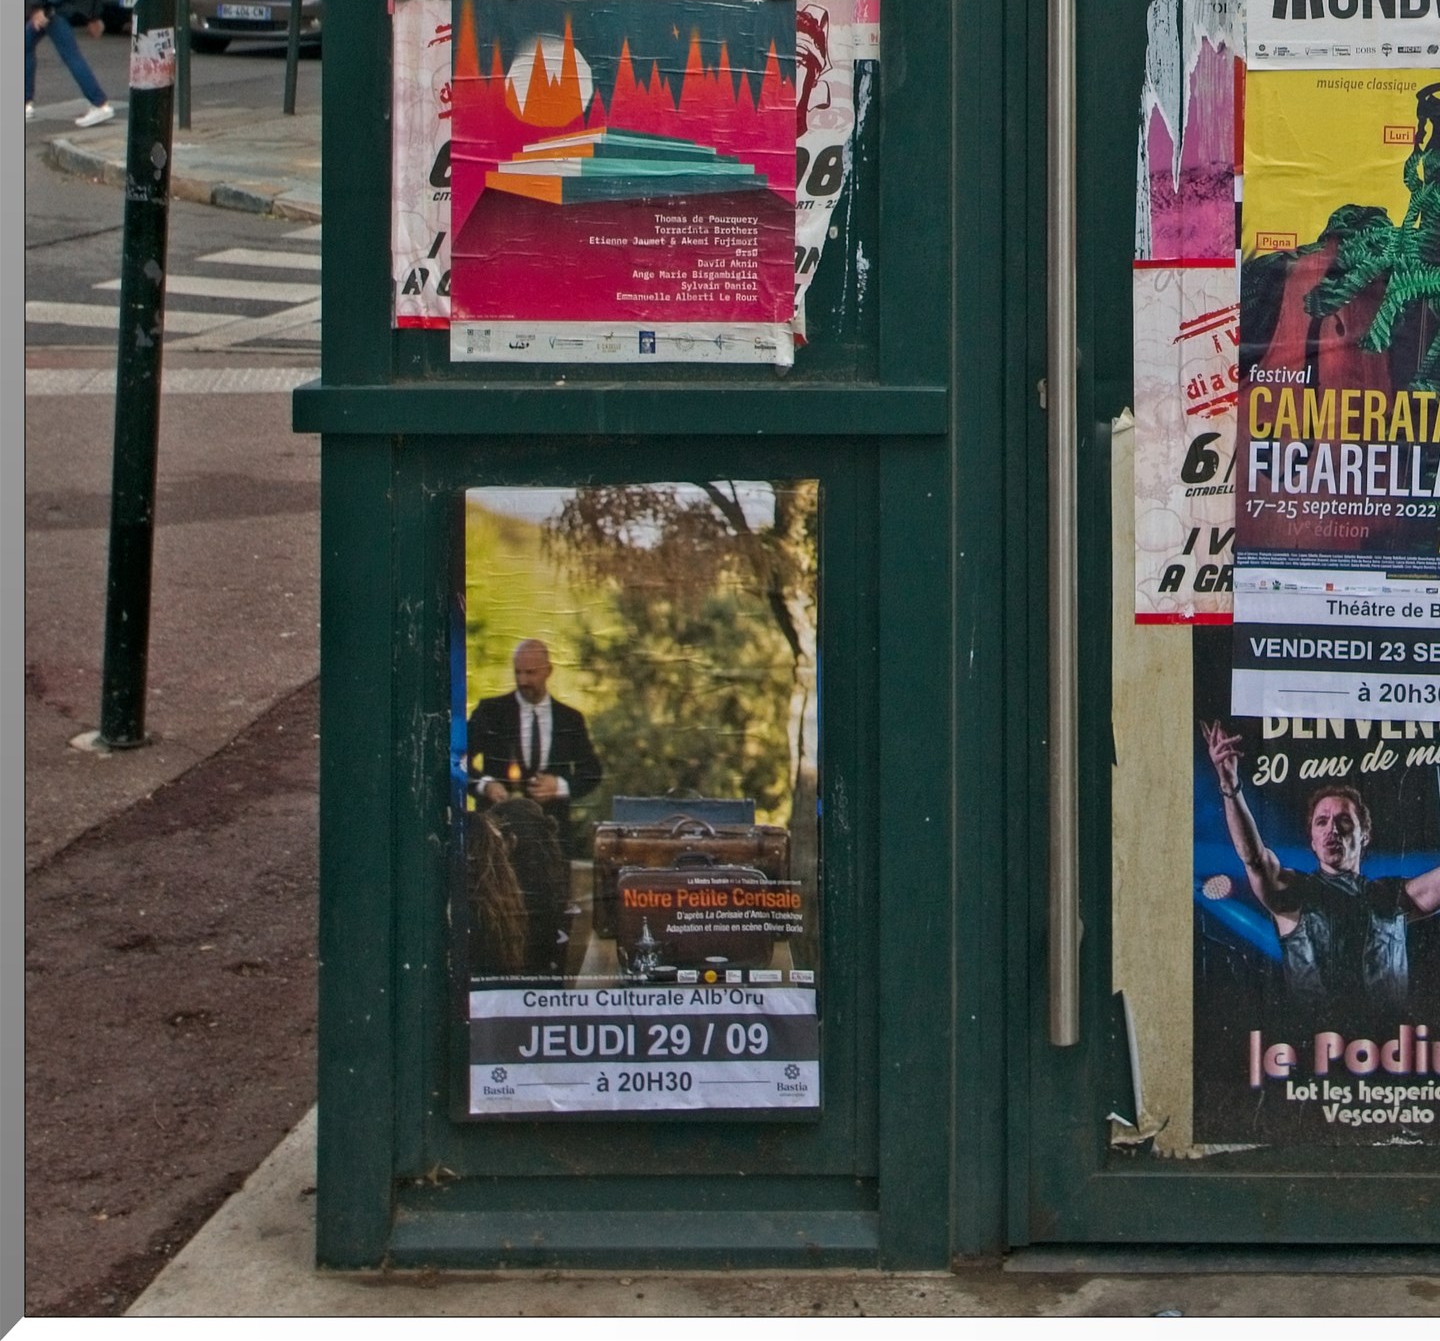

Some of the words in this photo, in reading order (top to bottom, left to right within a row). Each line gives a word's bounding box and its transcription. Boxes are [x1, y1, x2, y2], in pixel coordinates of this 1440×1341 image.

[1317, 78, 1364, 91] musique
[1367, 78, 1417, 92] classique
[1389, 130, 1410, 141] Luri
[654, 214, 687, 224] Thomas
[692, 214, 704, 224] de
[708, 215, 759, 226] Pourquery
[654, 225, 709, 235] Torracinta
[713, 226, 758, 235] Brothers
[589, 236, 628, 246] Etienne
[632, 236, 666, 246] Jaumet
[669, 236, 677, 246] &
[681, 236, 709, 246] Akemi
[713, 236, 758, 247] Fujimori
[1262, 237, 1291, 249] Pigna
[697, 259, 726, 268] David
[730, 259, 758, 268] Aknin
[632, 270, 655, 281] Ange
[659, 270, 687, 280] Marie
[692, 270, 758, 281] Bisgambiglia
[681, 282, 720, 292] Sylvain
[724, 282, 758, 291] Daniel
[616, 292, 671, 302] Emmanuelle
[675, 292, 714, 302] Alberti
[719, 292, 731, 302] Le
[735, 293, 758, 302] Roux
[1248, 364, 1311, 385] festival
[1302, 499, 1391, 519] septembre
[1395, 503, 1437, 518] 2022
[1327, 599, 1396, 620] Théâtre
[1401, 602, 1424, 620] de
[1249, 637, 1372, 661] VENDREDI
[1380, 641, 1406, 662] 23
[1357, 681, 1371, 703] à
[623, 888, 672, 908] Notre
[676, 888, 728, 908] Petite
[732, 887, 802, 908] Cerisaie
[666, 924, 703, 934] Adaptation
[713, 924, 730, 932] mise
[741, 923, 762, 932] scène
[522, 991, 589, 1007] Centru
[595, 989, 684, 1007] Culturale
[518, 1024, 635, 1057] JEUDI
[647, 1024, 691, 1056] 29
[702, 1023, 716, 1055] /
[725, 1023, 769, 1055] 09
[596, 1072, 610, 1092] à
[618, 1071, 693, 1092] 20H30
